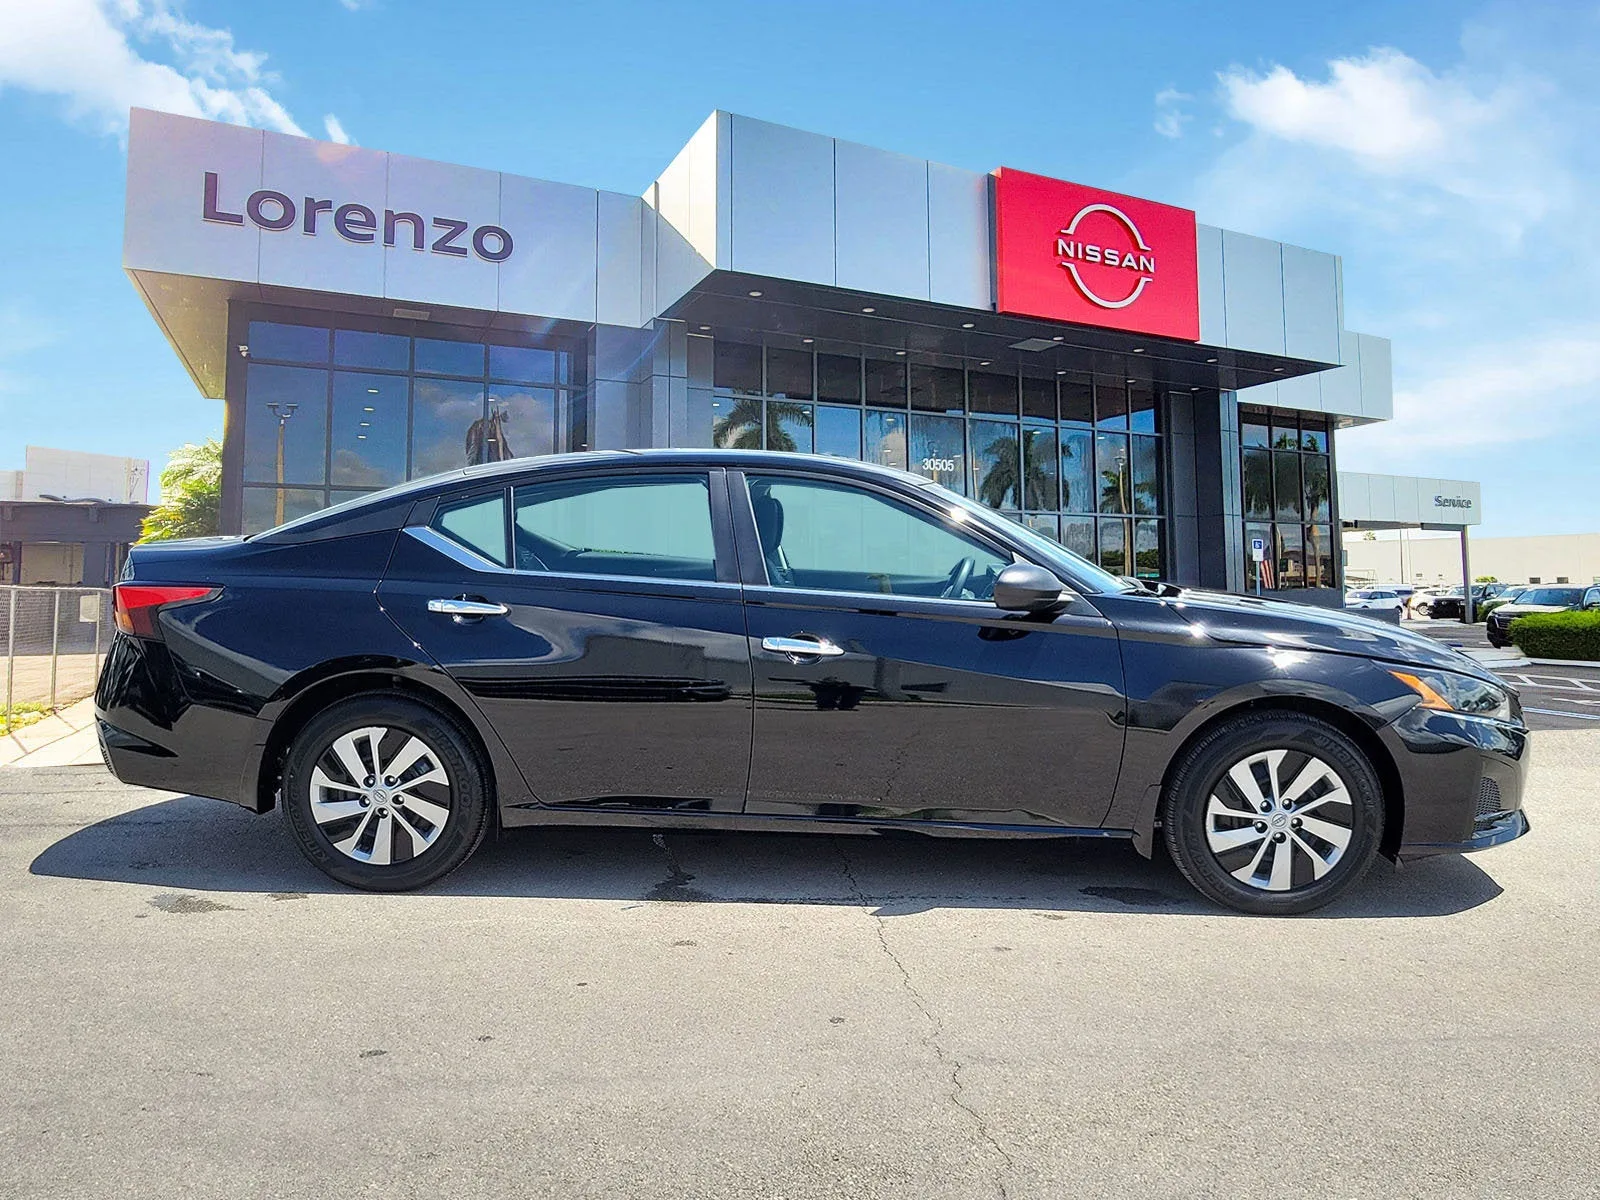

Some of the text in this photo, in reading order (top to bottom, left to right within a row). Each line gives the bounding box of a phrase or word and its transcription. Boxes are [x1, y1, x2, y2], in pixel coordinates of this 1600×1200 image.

[203, 171, 514, 262] Lorenzo
[1057, 238, 1155, 273] NISSAN
[922, 457, 954, 471] 30505
[1434, 495, 1472, 508] Service
